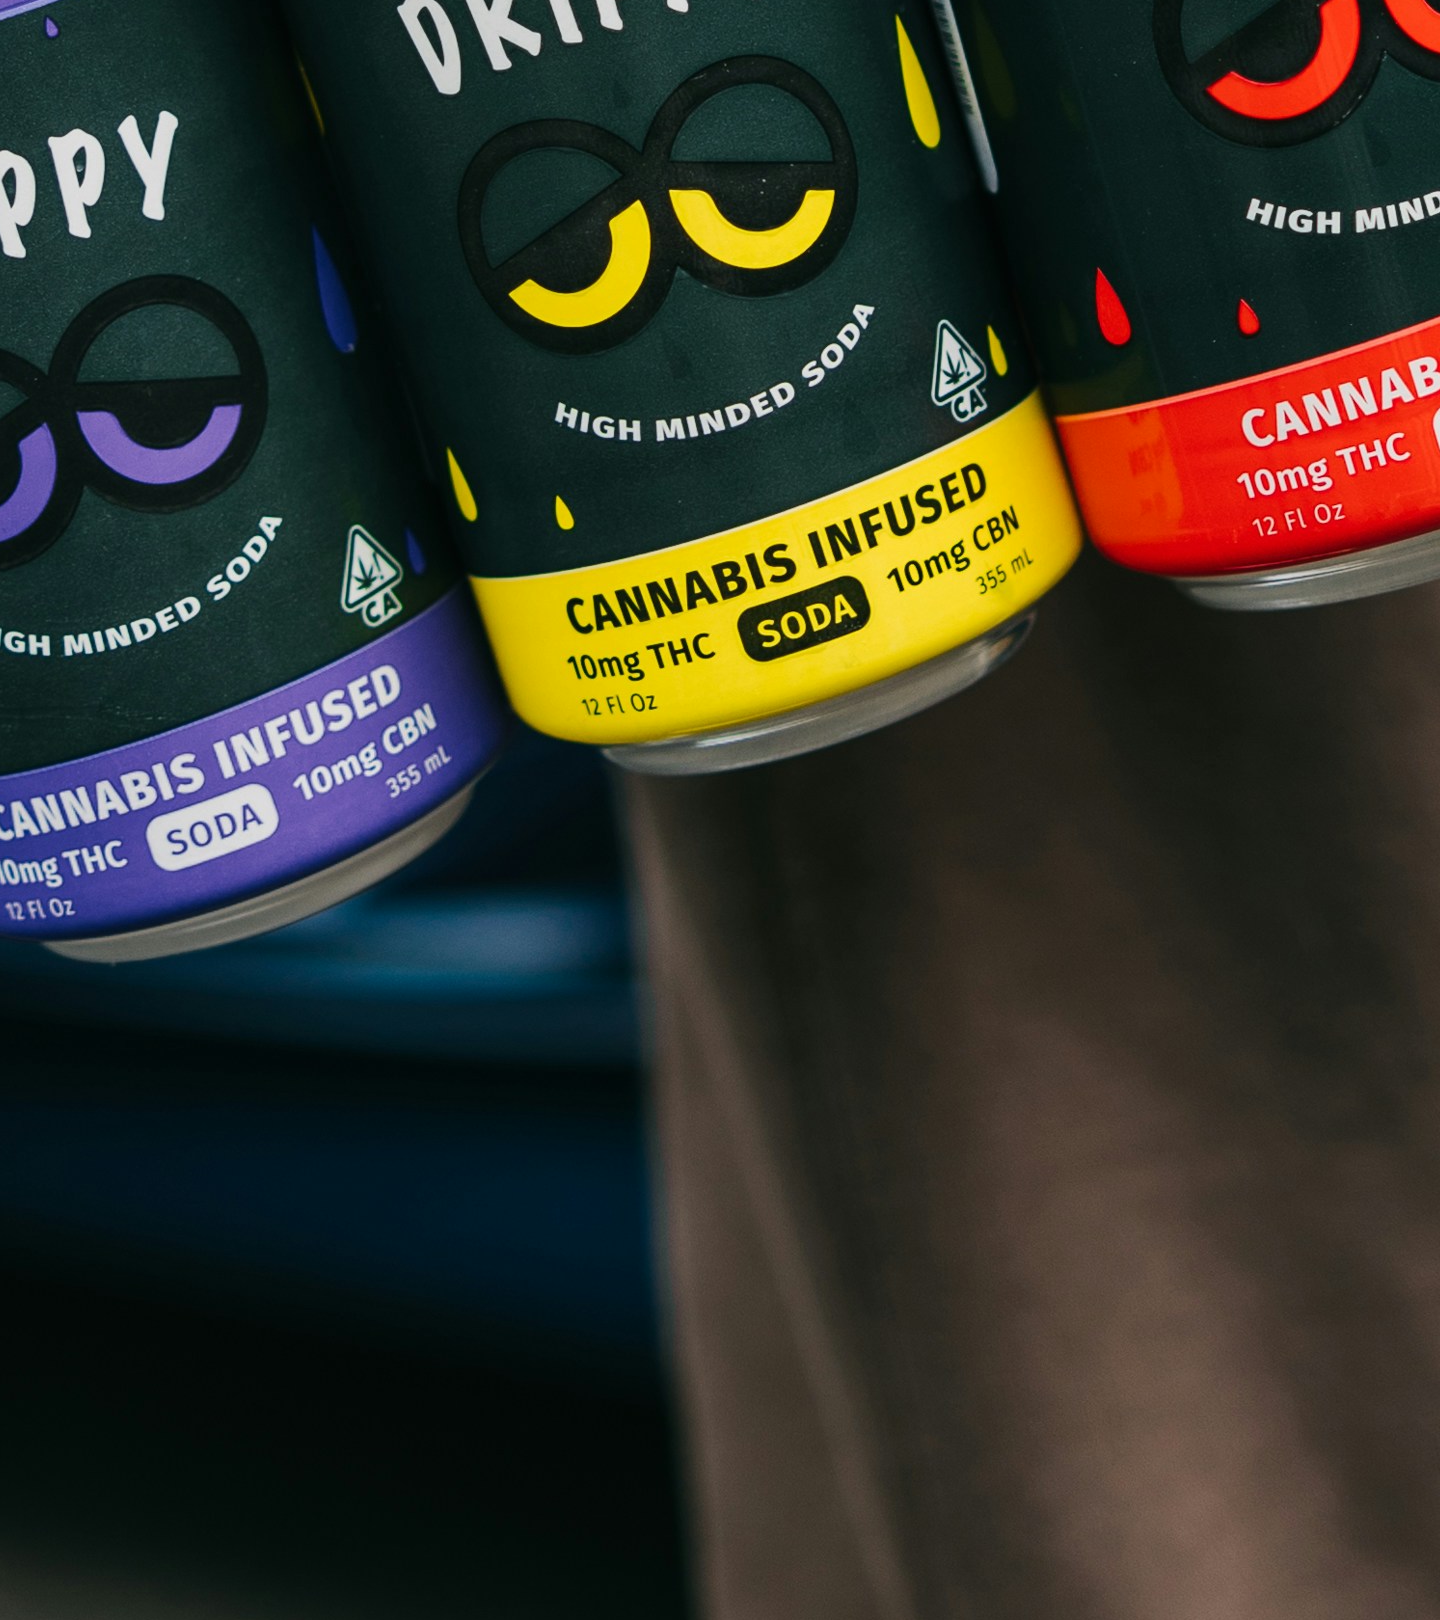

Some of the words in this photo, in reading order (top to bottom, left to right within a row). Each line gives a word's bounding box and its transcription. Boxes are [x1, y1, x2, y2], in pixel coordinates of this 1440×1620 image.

[1247, 199, 1340, 233] HIGH
[555, 403, 641, 441] HIGH
[656, 382, 795, 441] MINDED
[802, 305, 874, 387] SODA
[1237, 459, 1332, 498] 10mg
[1335, 433, 1410, 474] THC
[567, 544, 796, 634] CANNABIS
[808, 464, 986, 568] INFUSED
[1253, 517, 1277, 536] 12
[1314, 504, 1345, 523] Oz
[64, 597, 200, 656] MINDED
[207, 517, 282, 600] SODA
[568, 652, 645, 680] 10mg
[646, 633, 715, 668] THC
[758, 594, 857, 647] SODA
[887, 540, 970, 592] 10mg
[973, 506, 1019, 551] CBN
[975, 565, 1006, 594] 355
[214, 666, 400, 778] INFUSED
[582, 698, 601, 715] 12
[631, 693, 657, 712] Oz
[62, 841, 127, 875] THC
[167, 804, 262, 855] SODA
[294, 743, 382, 800] 10mg
[383, 704, 436, 754] CBN
[386, 765, 421, 797] 355
[5, 902, 25, 920] 12
[49, 898, 75, 917] Oz
